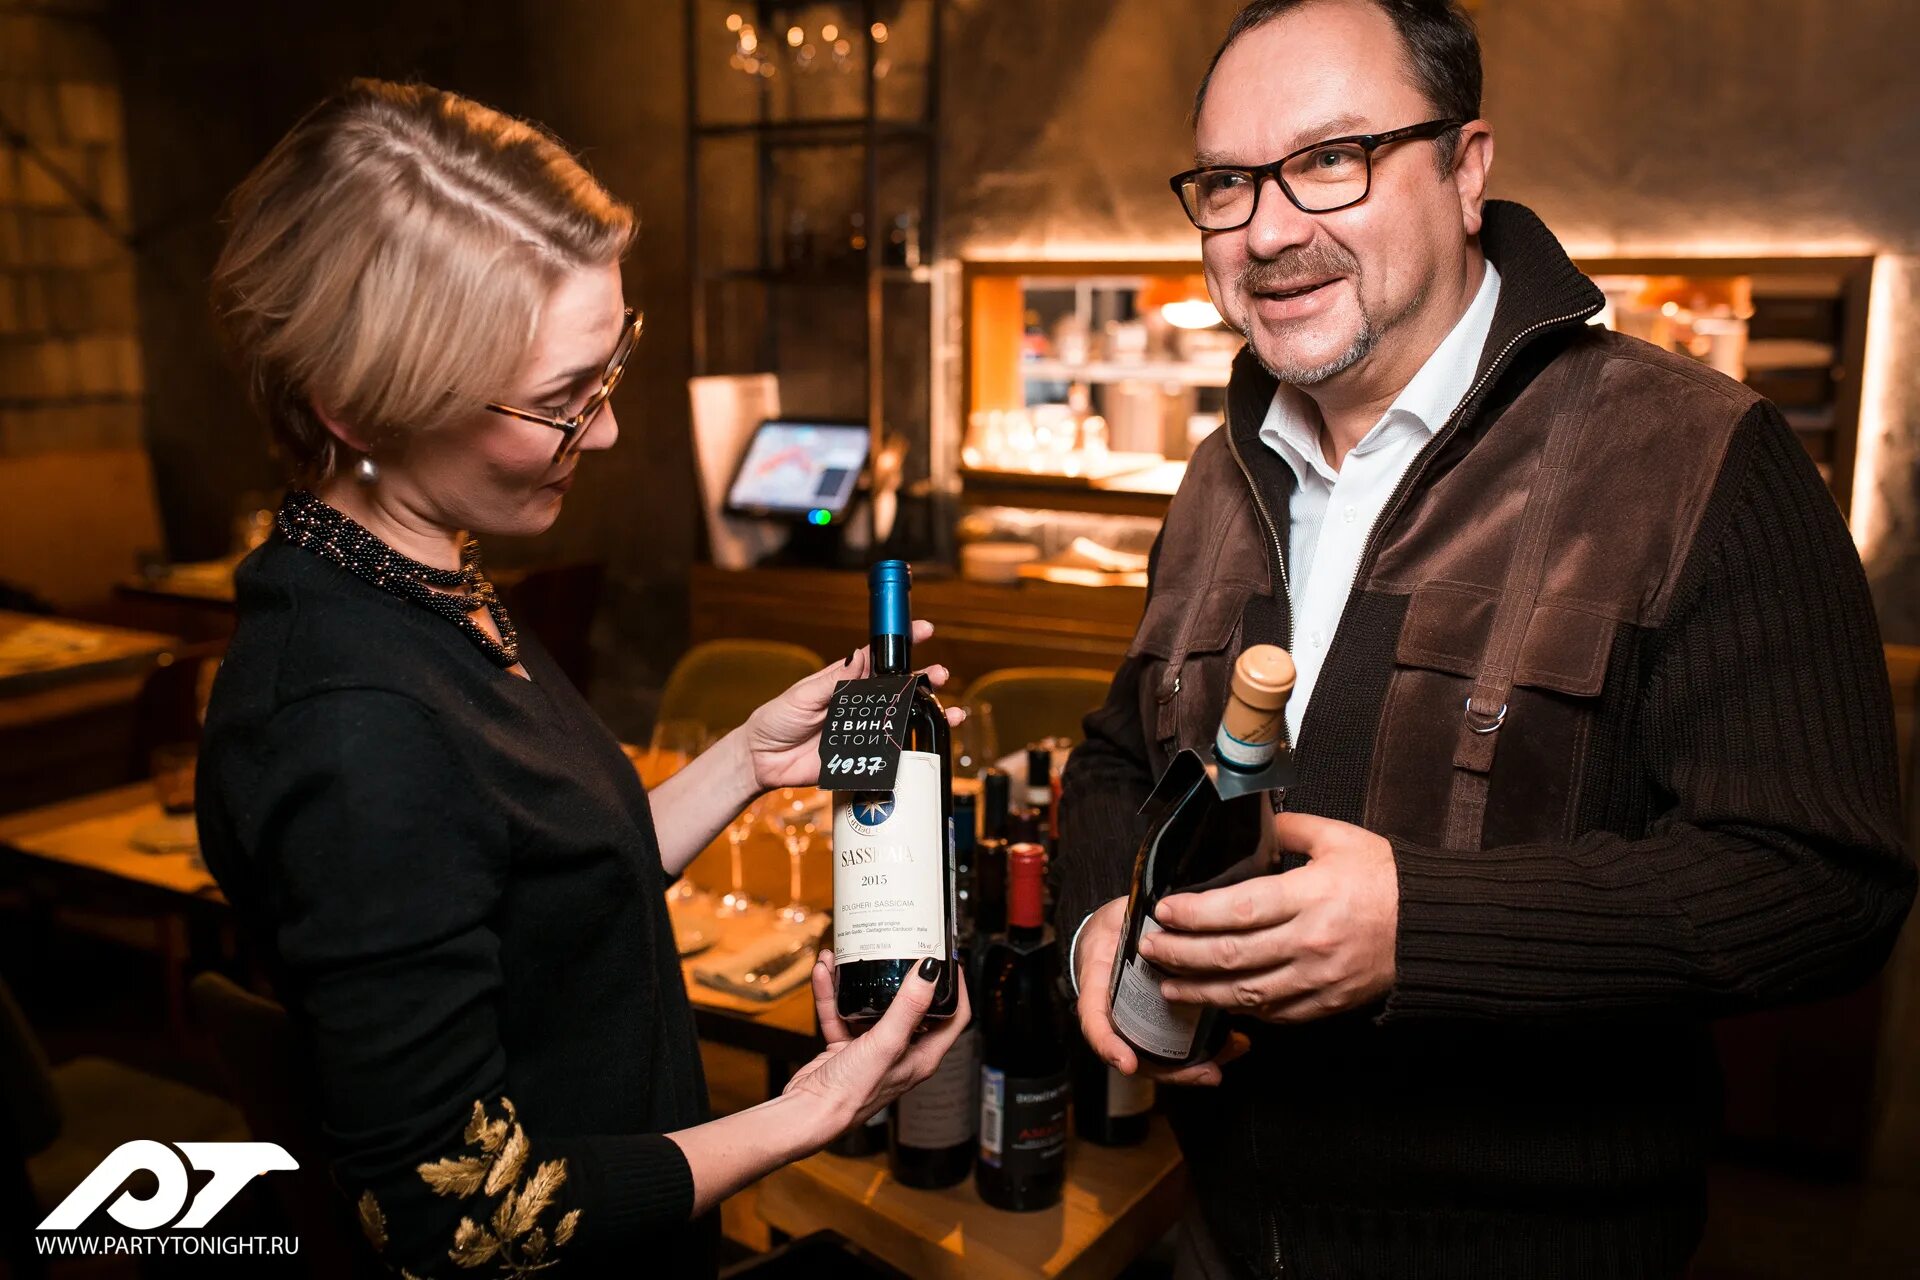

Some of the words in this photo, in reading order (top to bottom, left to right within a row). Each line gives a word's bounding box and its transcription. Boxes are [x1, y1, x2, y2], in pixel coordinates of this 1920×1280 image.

[838, 693, 901, 705] БОКАЛ
[834, 707, 897, 718] ЭТОГО
[843, 720, 894, 731] ВИНА
[828, 734, 893, 746] СТОИТ
[841, 845, 915, 868] SASSIAIA
[861, 874, 888, 887] 2015
[841, 901, 872, 912] BOLGHERI
[874, 900, 915, 908] SASSICAIA
